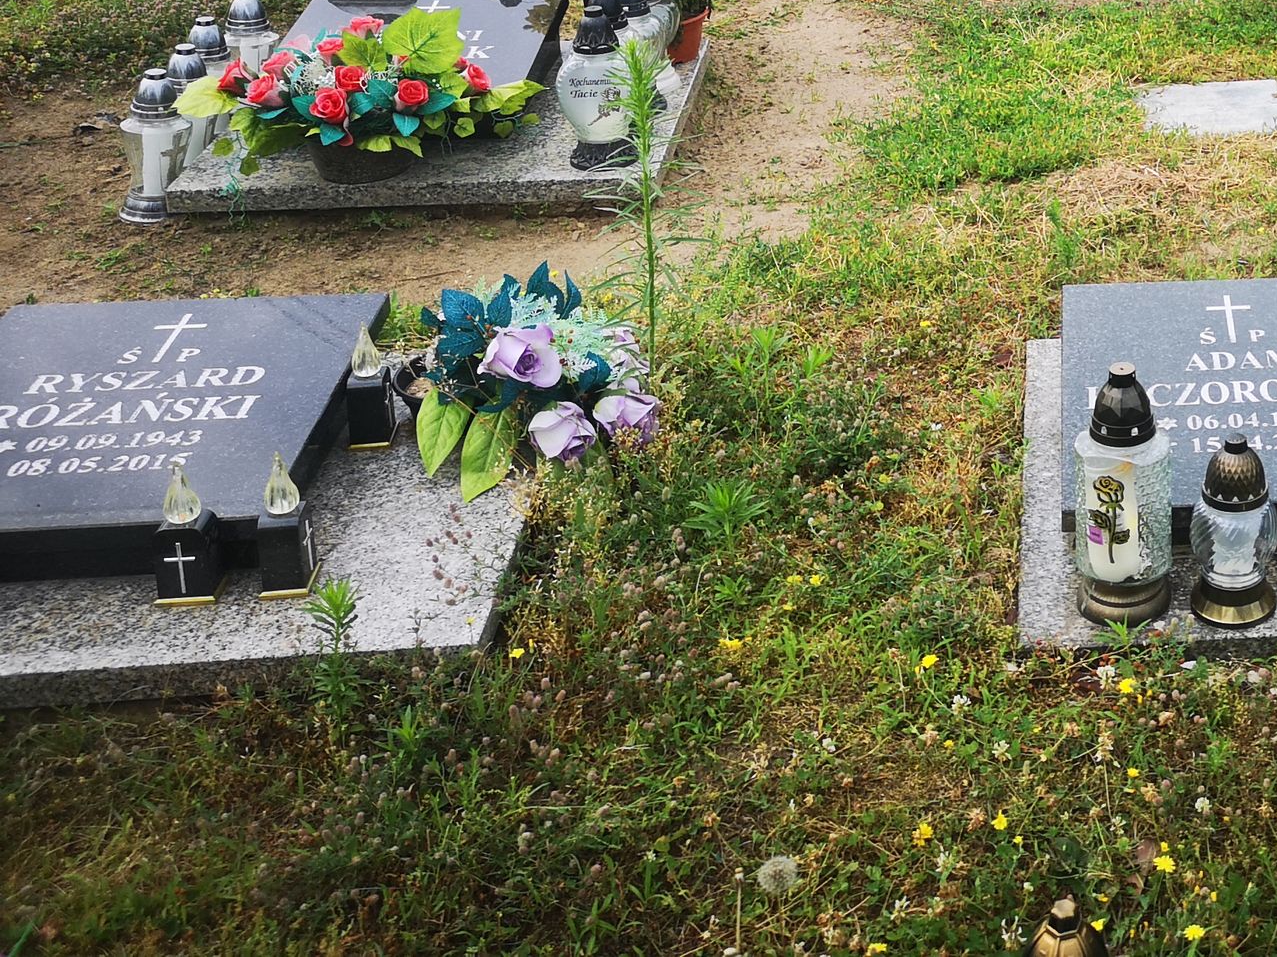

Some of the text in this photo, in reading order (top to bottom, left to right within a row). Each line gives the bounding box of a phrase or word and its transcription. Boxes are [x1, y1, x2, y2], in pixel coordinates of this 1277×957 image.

[1200, 327, 1265, 345] Ś P
[117, 347, 201, 364] Ś P
[23, 365, 266, 395] RYSZARD
[0, 392, 261, 430] RÓŻAŃSKI
[25, 430, 204, 453] 09.09.1943
